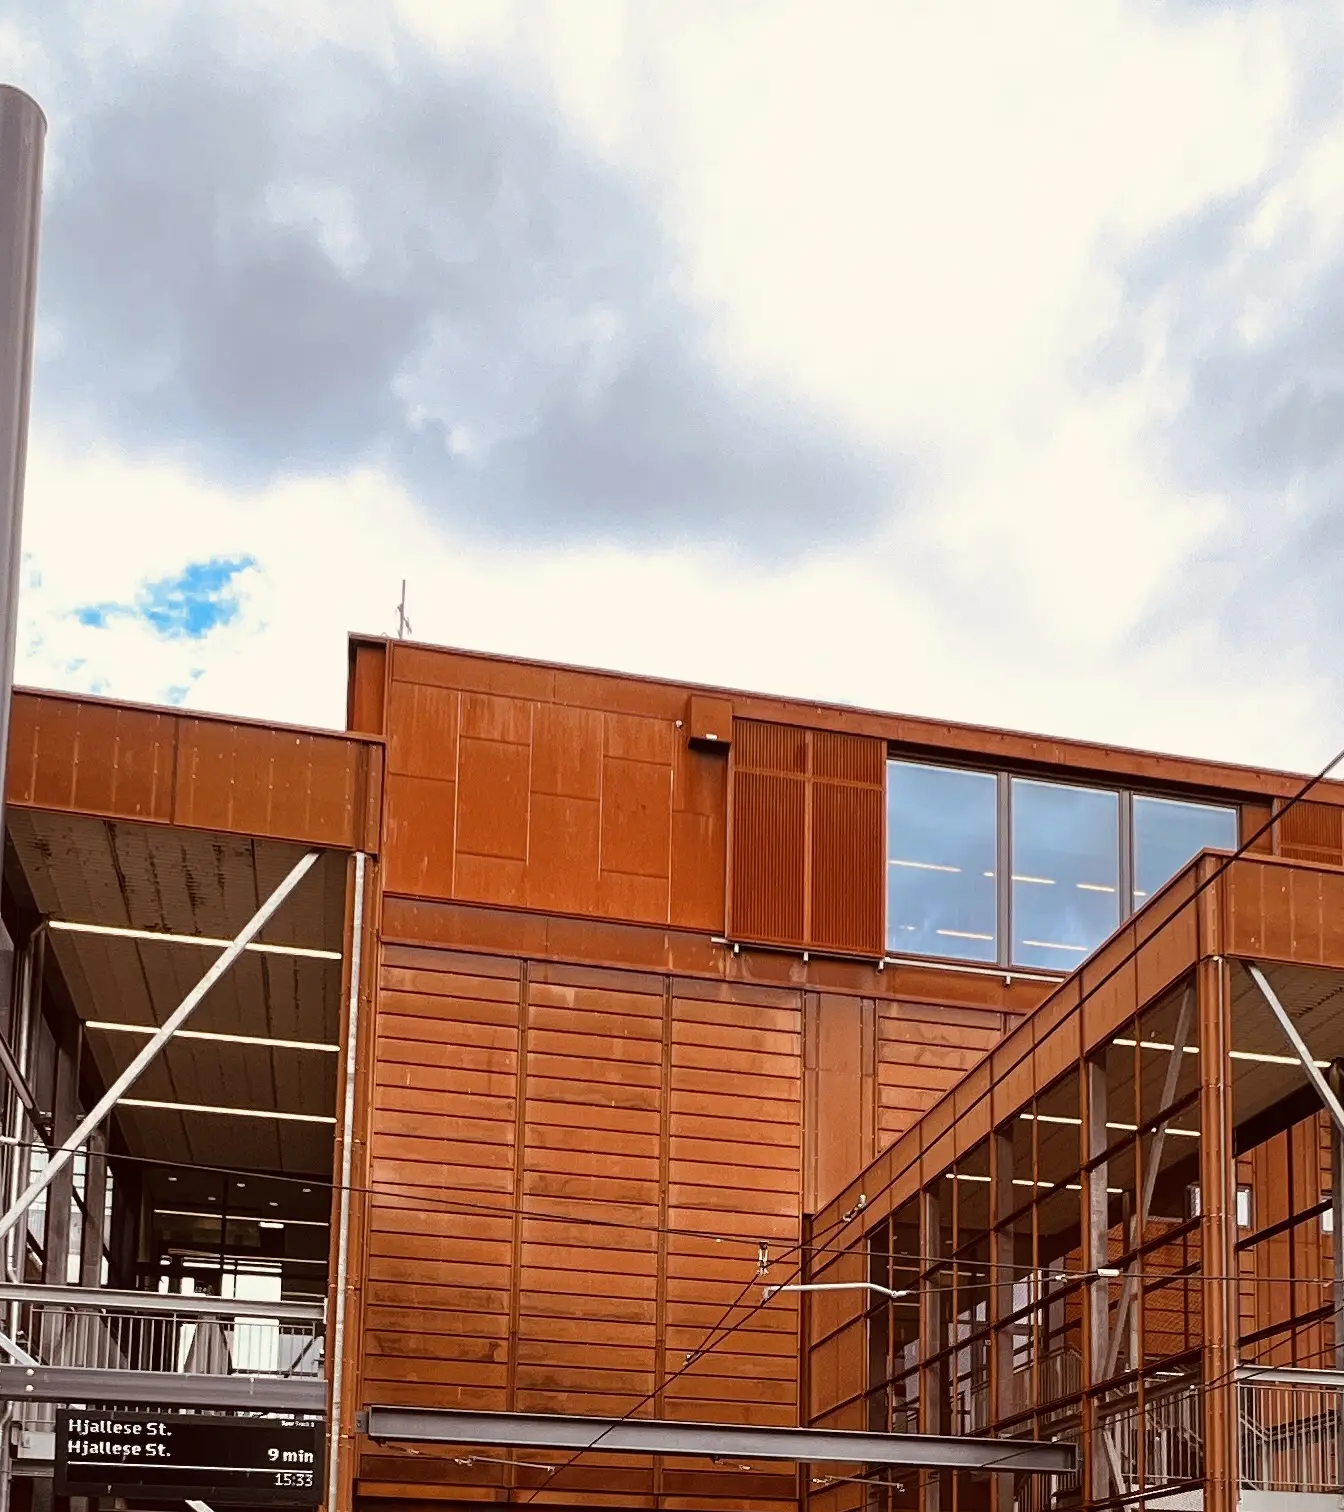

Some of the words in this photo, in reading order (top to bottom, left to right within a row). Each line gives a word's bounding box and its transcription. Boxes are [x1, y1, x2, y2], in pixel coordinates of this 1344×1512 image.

[68, 1419, 142, 1435] Hjallese
[146, 1423, 172, 1436] St.
[67, 1440, 142, 1456] Hjallese
[145, 1443, 171, 1457] St.
[267, 1448, 280, 1461] 9
[282, 1449, 314, 1463] min
[275, 1473, 313, 1487] 15:33
